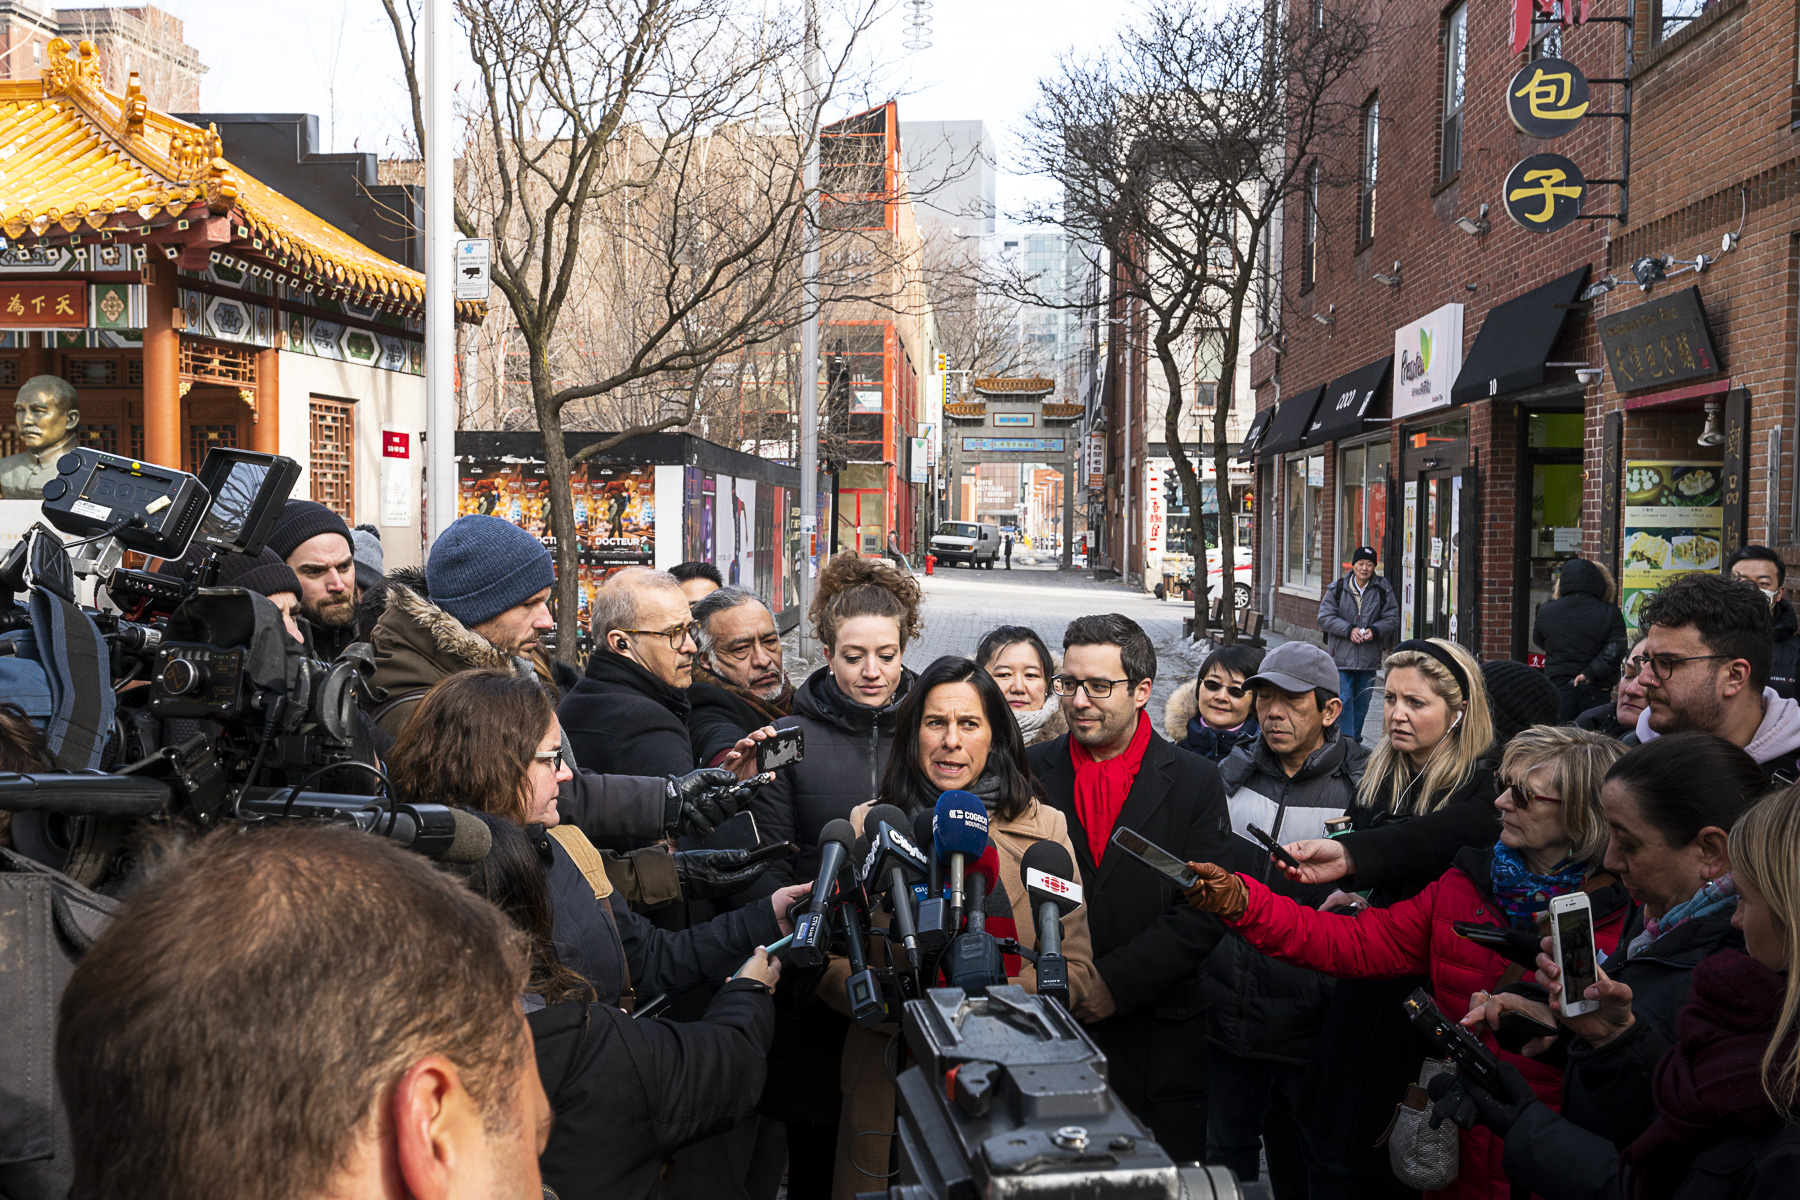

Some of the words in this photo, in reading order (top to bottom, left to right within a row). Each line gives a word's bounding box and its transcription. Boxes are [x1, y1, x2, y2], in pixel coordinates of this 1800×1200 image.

[1514, 68, 1590, 223] 包子
[1489, 378, 1497, 396] 10
[965, 820, 988, 833] NOUVELLES
